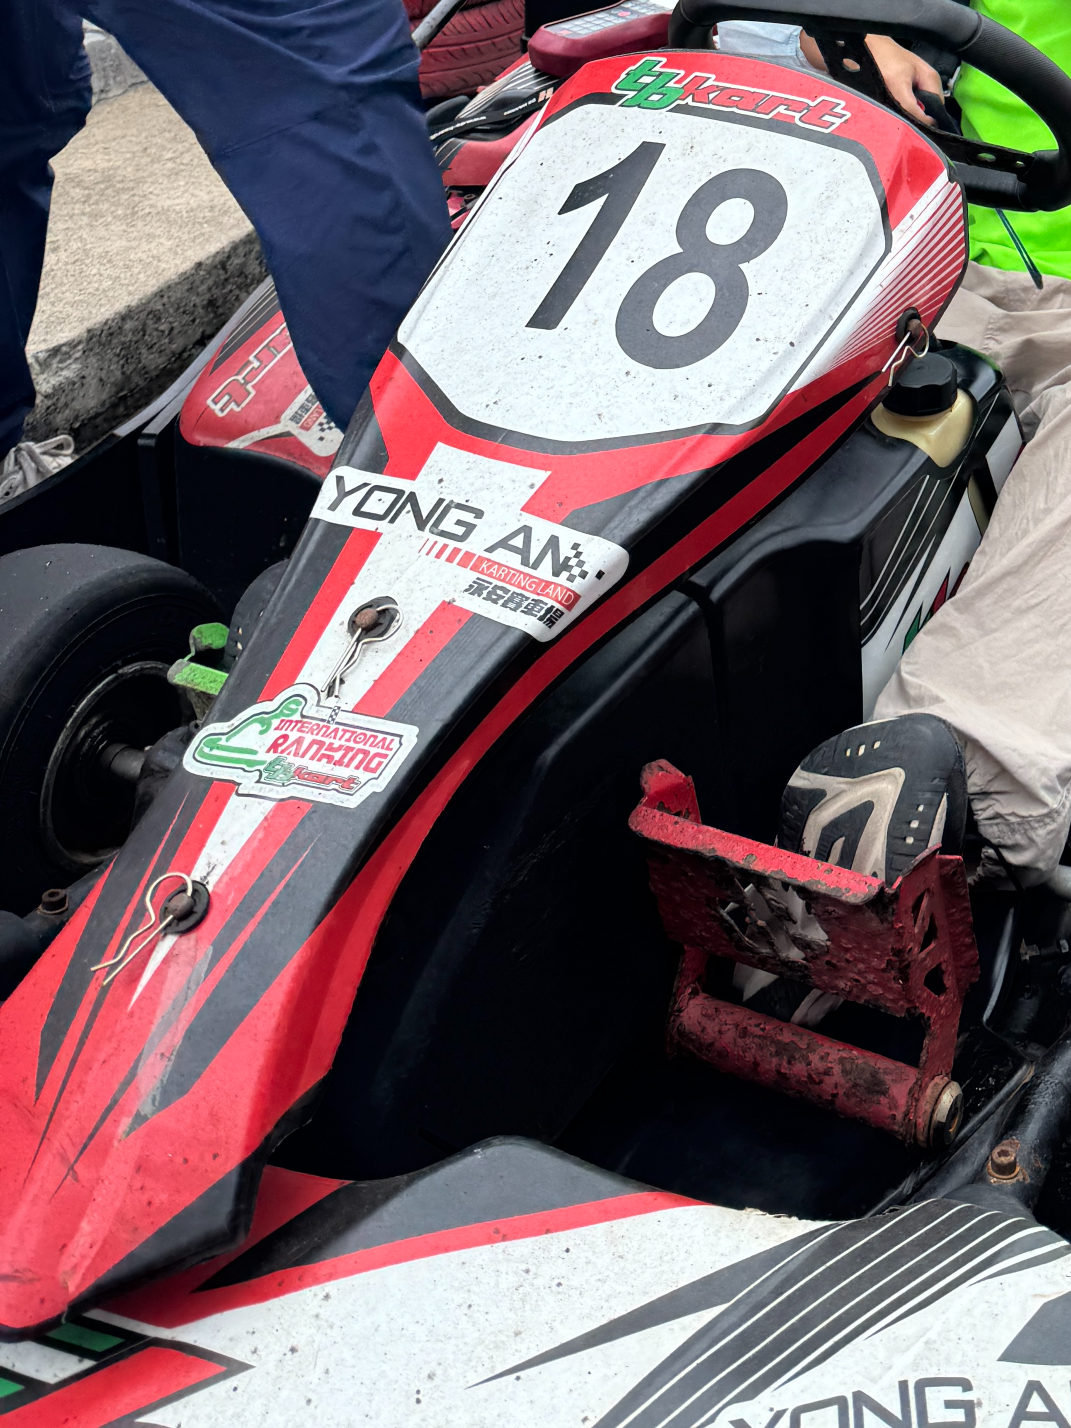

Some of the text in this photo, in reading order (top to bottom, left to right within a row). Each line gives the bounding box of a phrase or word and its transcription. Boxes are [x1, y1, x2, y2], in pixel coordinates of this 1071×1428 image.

[525, 141, 788, 369] 18
[327, 475, 576, 582] YONG AN
[479, 559, 575, 605] KARTING LAND
[265, 734, 389, 774] RANKING
[274, 719, 395, 751] INTERNATIONAL
